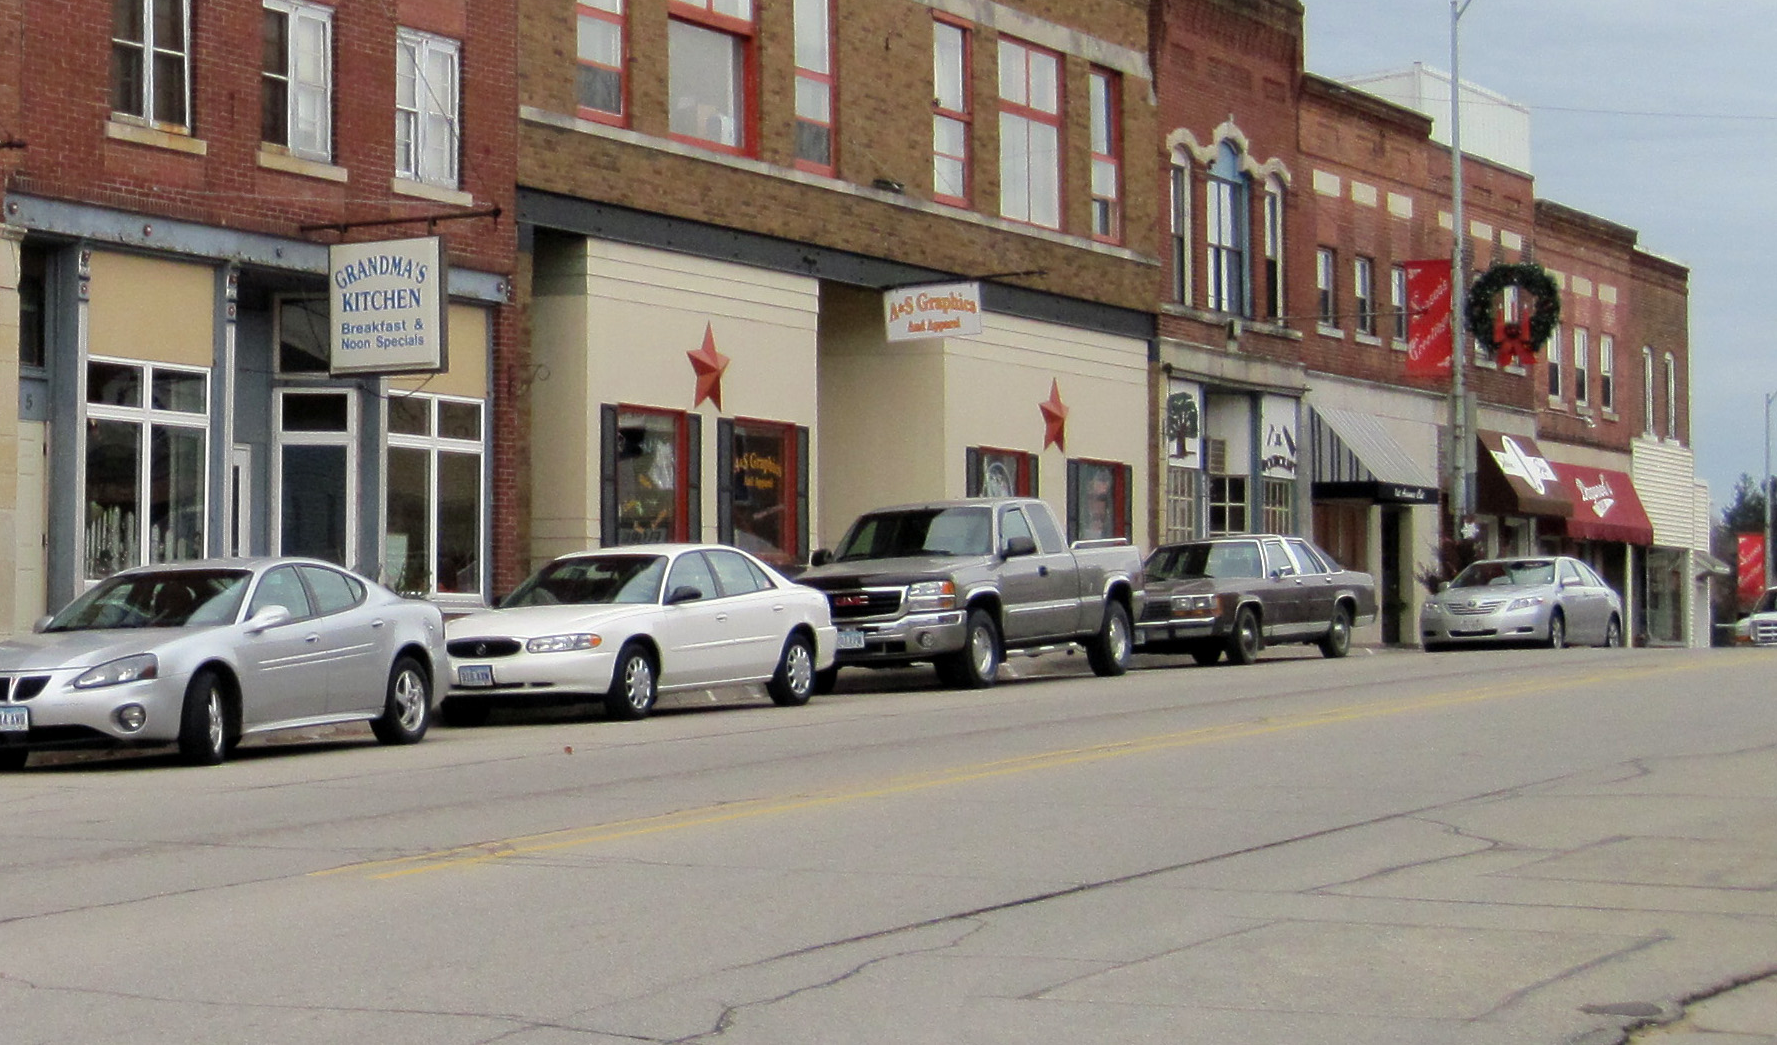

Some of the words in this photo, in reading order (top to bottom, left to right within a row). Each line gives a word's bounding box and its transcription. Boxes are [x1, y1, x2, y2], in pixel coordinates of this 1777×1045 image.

[335, 255, 427, 289] GRANDMA'S
[342, 288, 421, 313] KITCHEN
[916, 291, 977, 314] Graphics
[341, 320, 406, 335] Breakfast
[414, 318, 423, 330] &
[341, 338, 371, 350] Noon
[376, 334, 424, 350] Specials
[25, 393, 33, 410] 5
